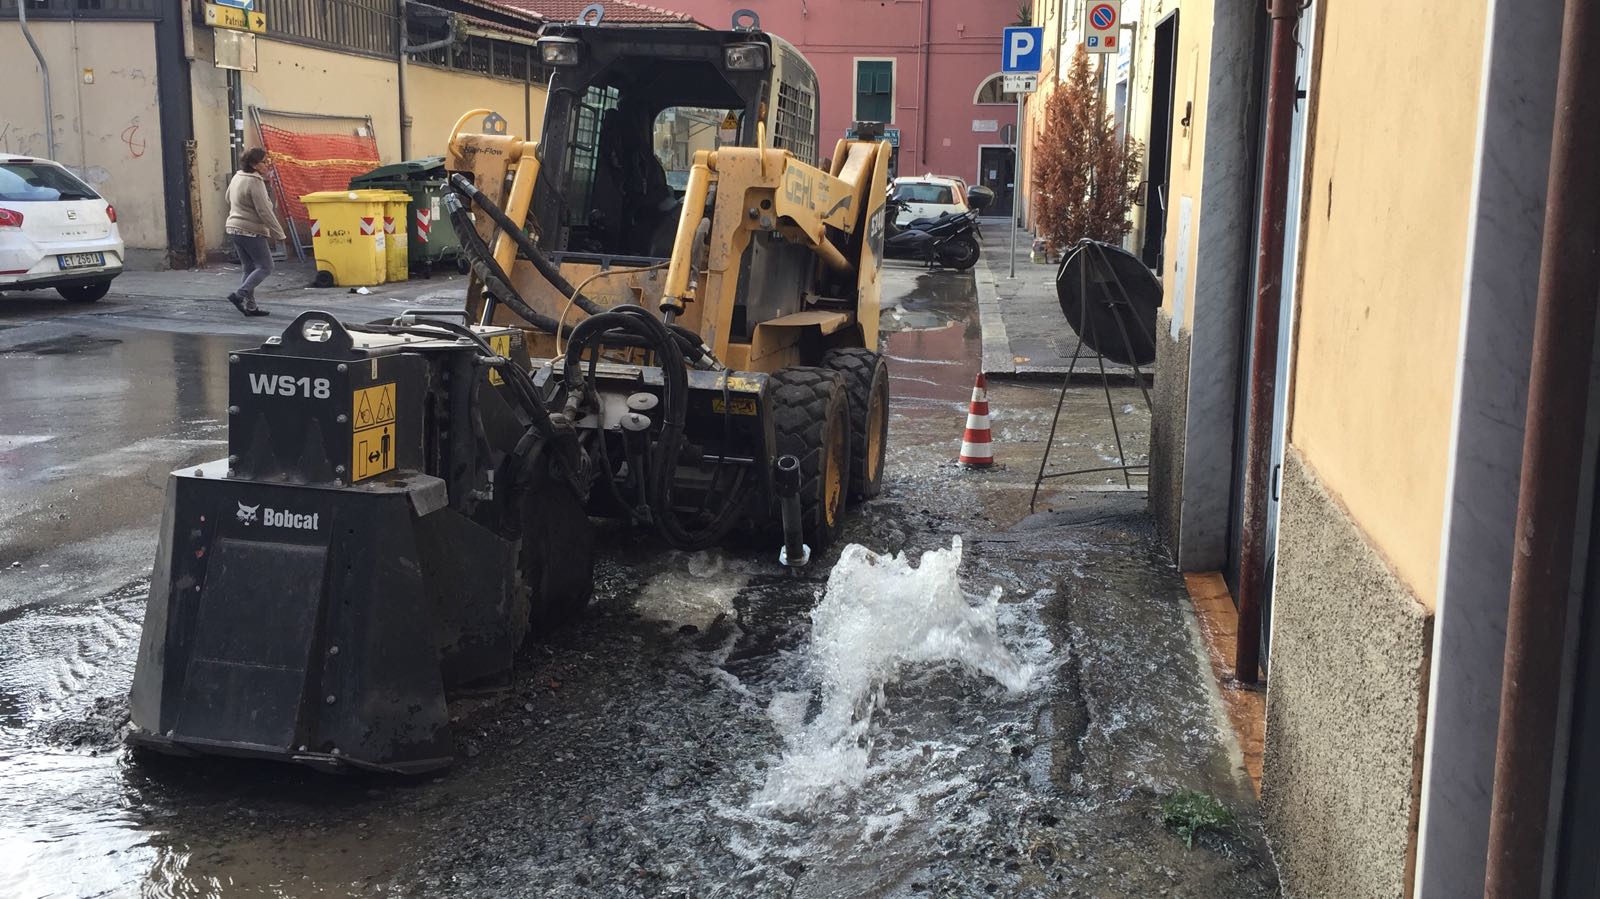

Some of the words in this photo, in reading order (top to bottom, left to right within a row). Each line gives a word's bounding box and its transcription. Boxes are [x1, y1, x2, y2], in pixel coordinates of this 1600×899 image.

[1010, 32, 1034, 68] P
[1089, 37, 1097, 46] P
[249, 373, 331, 399] WS18
[263, 508, 319, 530] Bobcat
